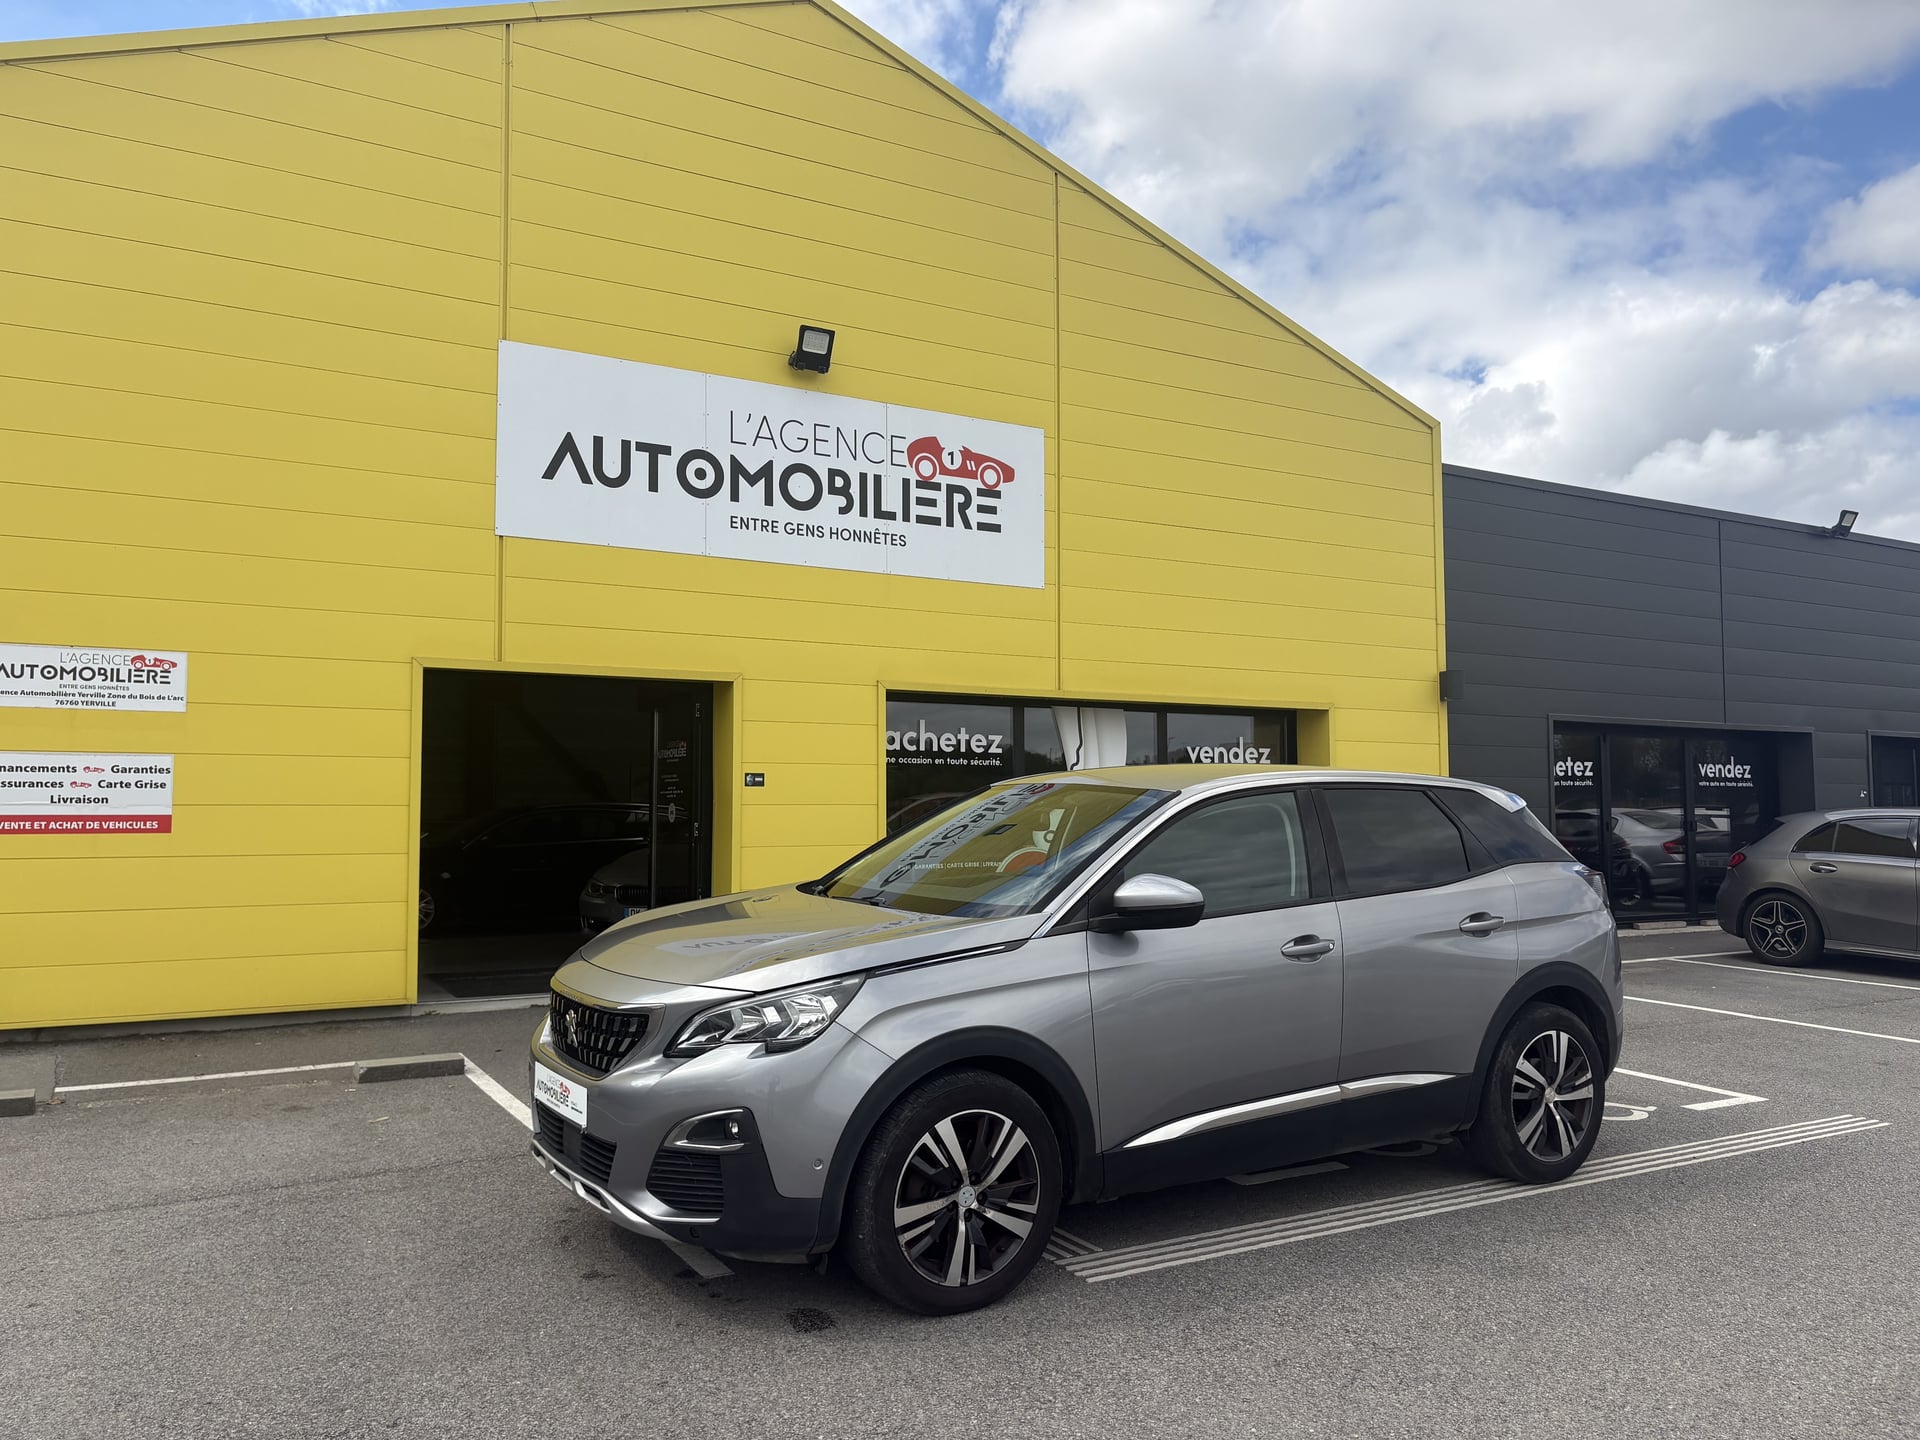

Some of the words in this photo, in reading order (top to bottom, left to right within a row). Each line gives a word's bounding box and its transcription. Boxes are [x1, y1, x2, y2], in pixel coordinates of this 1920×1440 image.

[730, 410, 907, 467] L'AGENCE
[730, 515, 779, 534] ENTRE
[783, 521, 825, 539] GENS
[829, 526, 907, 547] HONNÊTES
[60, 651, 132, 666] L'AGENCE
[20, 689, 76, 698] Automobilière
[885, 719, 1003, 754] achetez
[1186, 736, 1271, 764] vendez
[898, 755, 933, 765] occasion
[947, 757, 967, 766] toute
[970, 756, 1003, 767] sécurité.
[1553, 756, 1594, 776] etez
[1698, 755, 1752, 778] vendez
[110, 764, 171, 774] Garanties
[0, 780, 64, 788] ssurances
[97, 779, 132, 789] Carte
[134, 779, 167, 789] Grise
[50, 794, 109, 804] Livraison
[34, 821, 47, 830] ET
[49, 821, 84, 829] ACHAT
[86, 821, 100, 829] DE
[102, 821, 159, 829] VEHICULES
